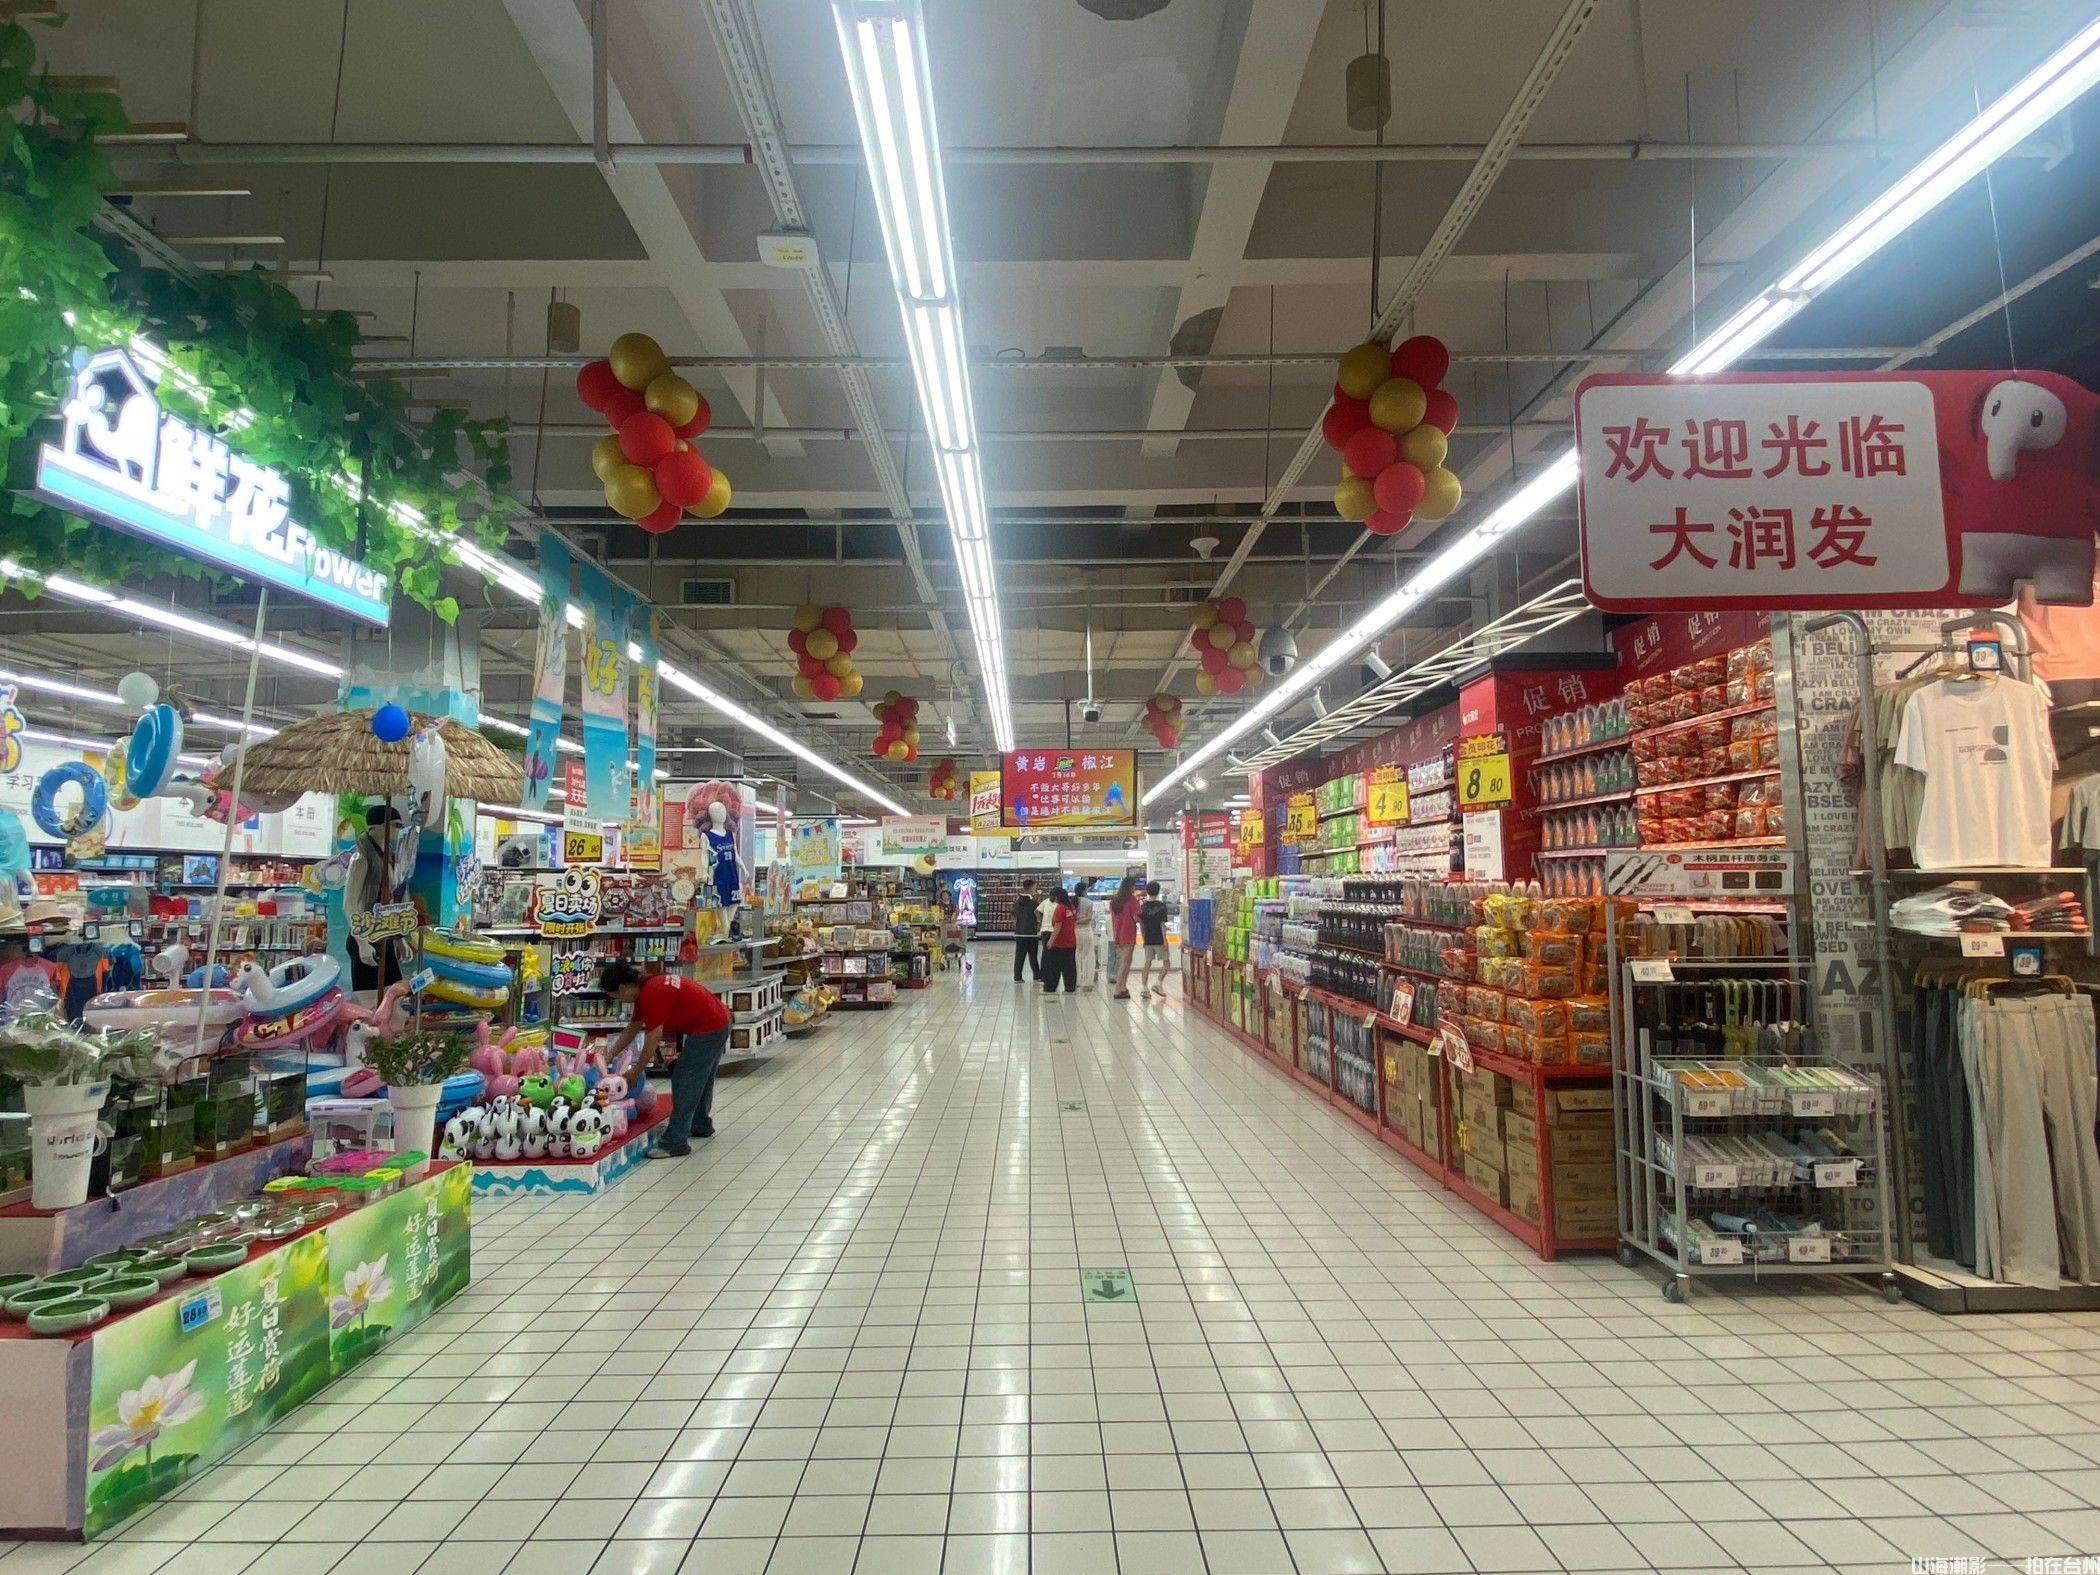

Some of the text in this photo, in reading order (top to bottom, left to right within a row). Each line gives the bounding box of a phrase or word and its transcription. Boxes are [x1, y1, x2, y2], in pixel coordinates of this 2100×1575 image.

[1602, 414, 1907, 483] 欢迎光临
[158, 415, 291, 560] 鲜花
[1649, 504, 1878, 570] 大润发
[1633, 622, 1661, 660] 促销
[1522, 675, 1588, 716] 促销
[1015, 755, 1115, 772] 黄岩 椒江
[1466, 768, 1482, 800] 8
[1375, 793, 1387, 818] 4
[1820, 812, 1848, 820] LOVE
[1823, 824, 1856, 832] CRAZY
[568, 838, 586, 856] 26
[541, 891, 598, 915] 夏日卖场
[182, 1307, 197, 1325] 28
[253, 1269, 288, 1394] 夏日赏荷
